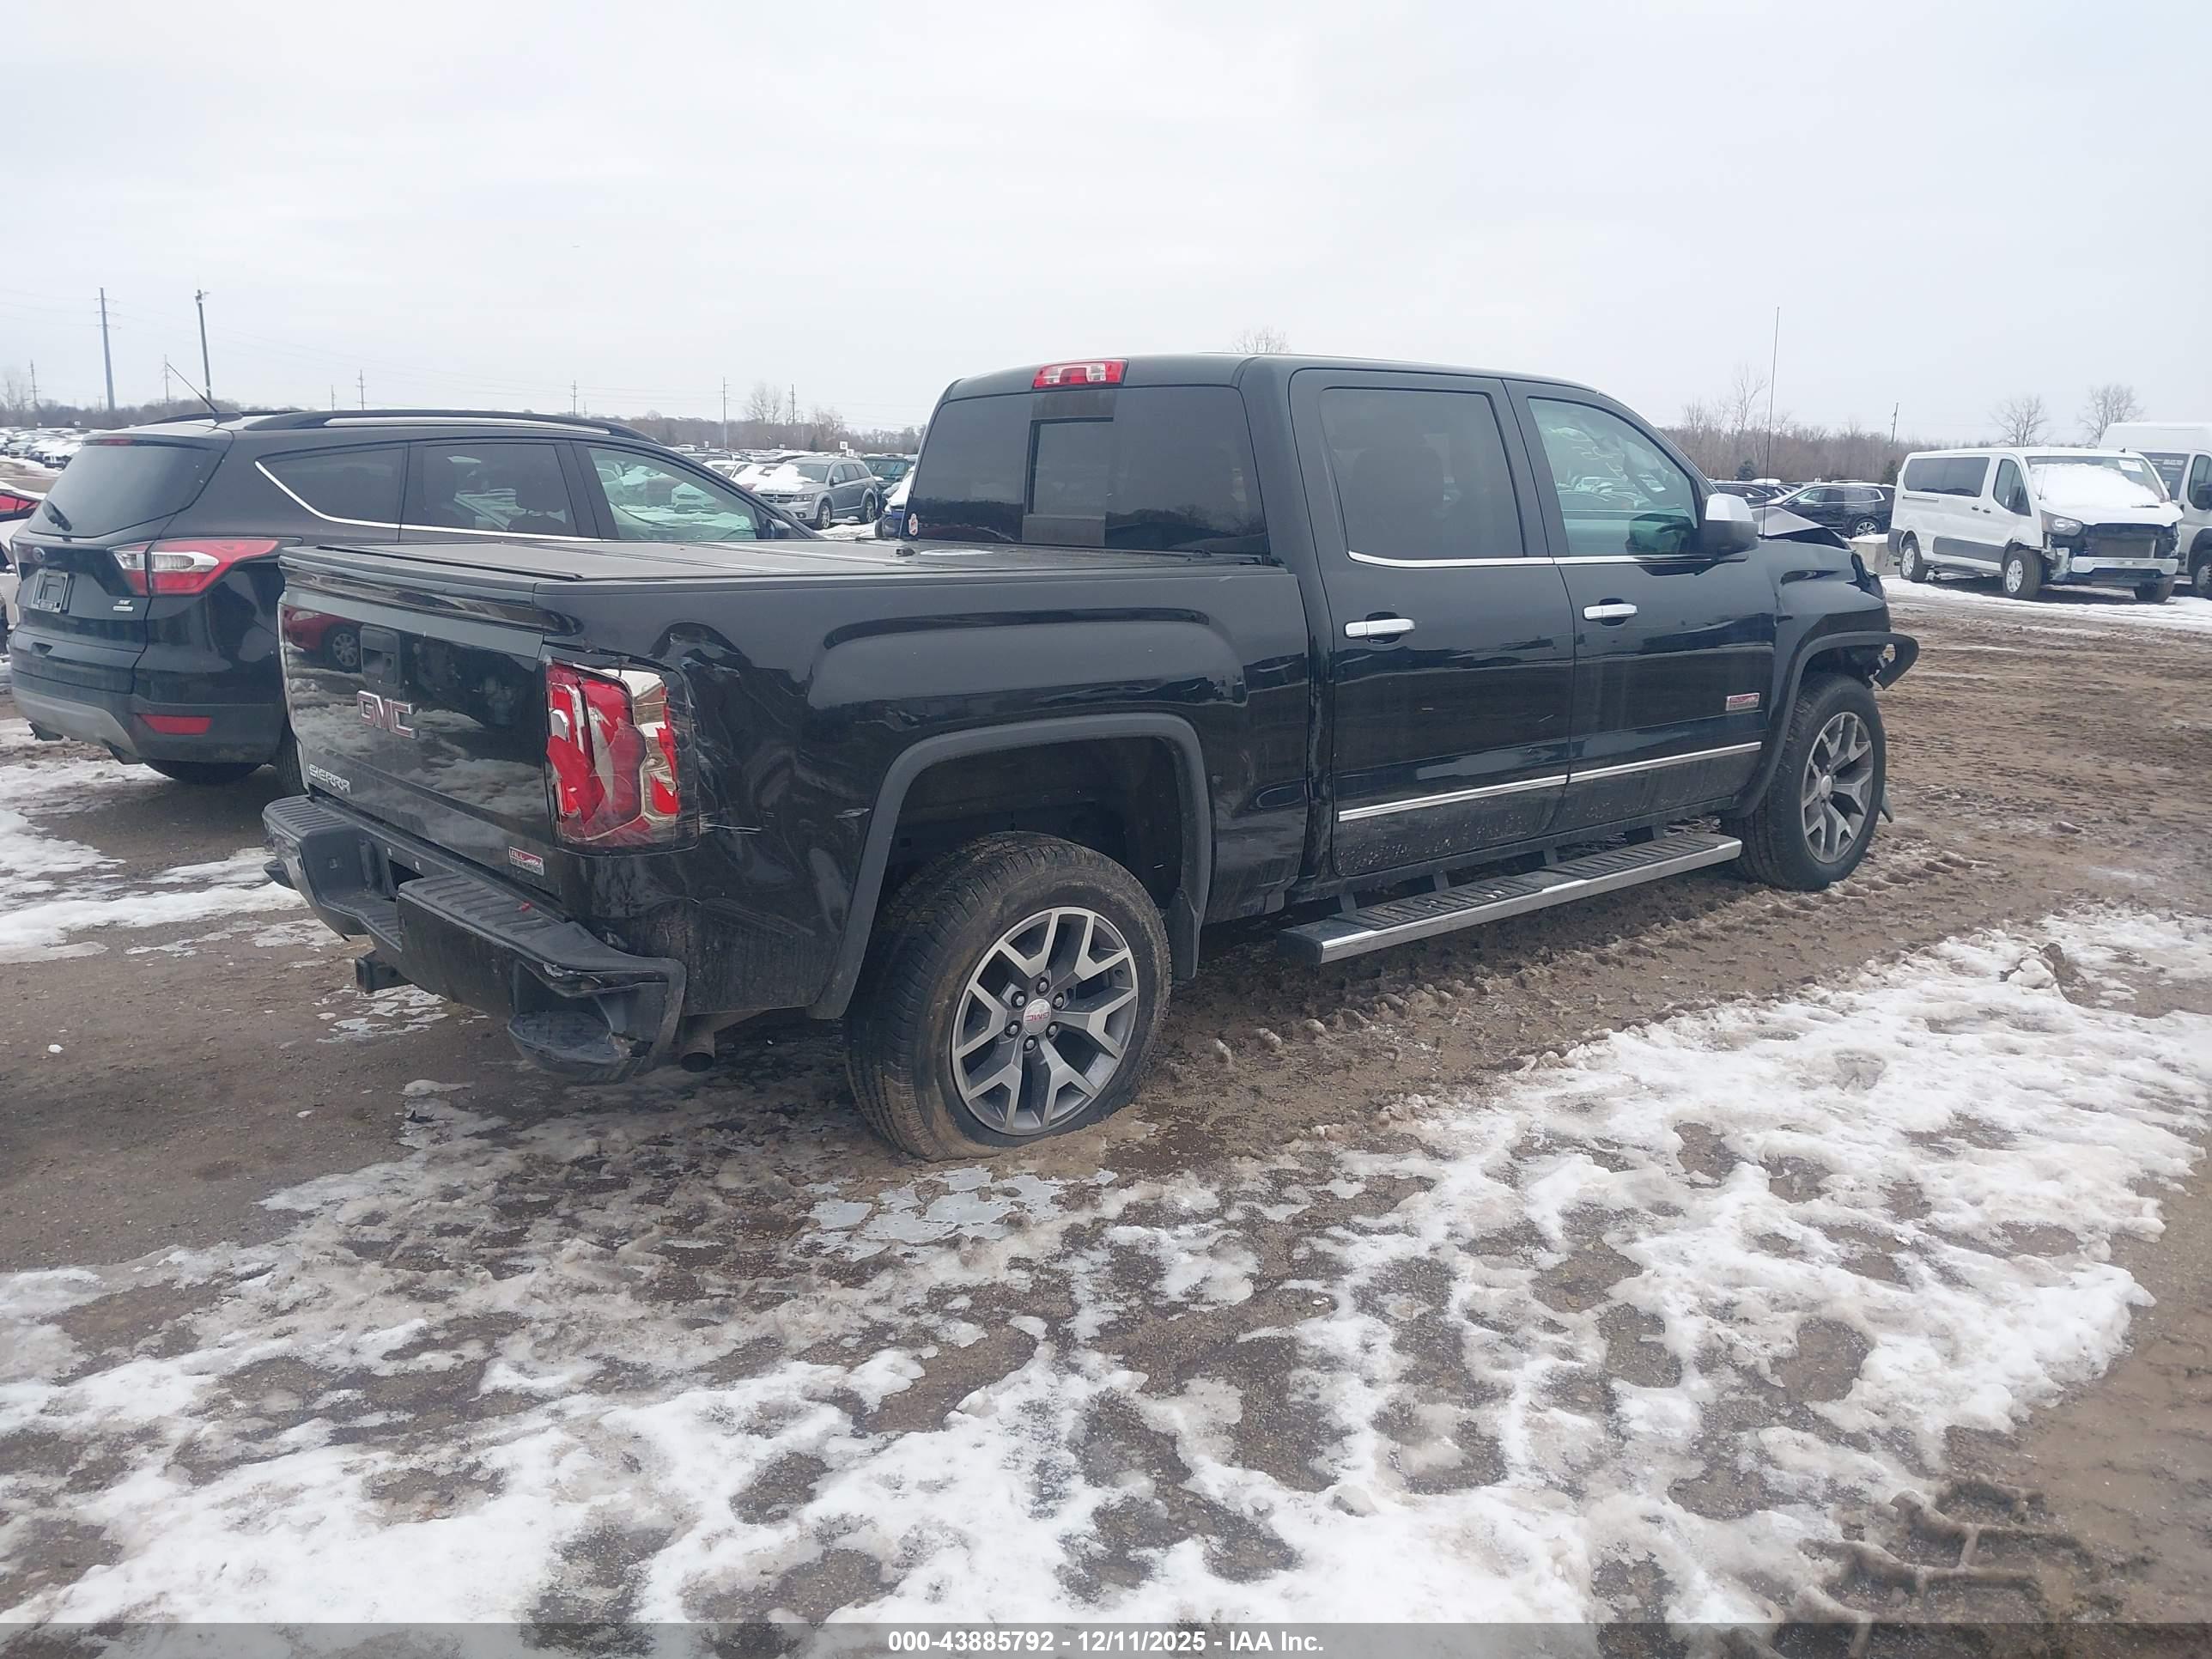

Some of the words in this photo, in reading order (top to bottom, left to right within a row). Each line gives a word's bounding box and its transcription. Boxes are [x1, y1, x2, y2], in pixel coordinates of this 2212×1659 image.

[356, 690, 418, 739] GMC
[309, 763, 351, 793] SIERRA
[1024, 1012, 1050, 1022] GMC
